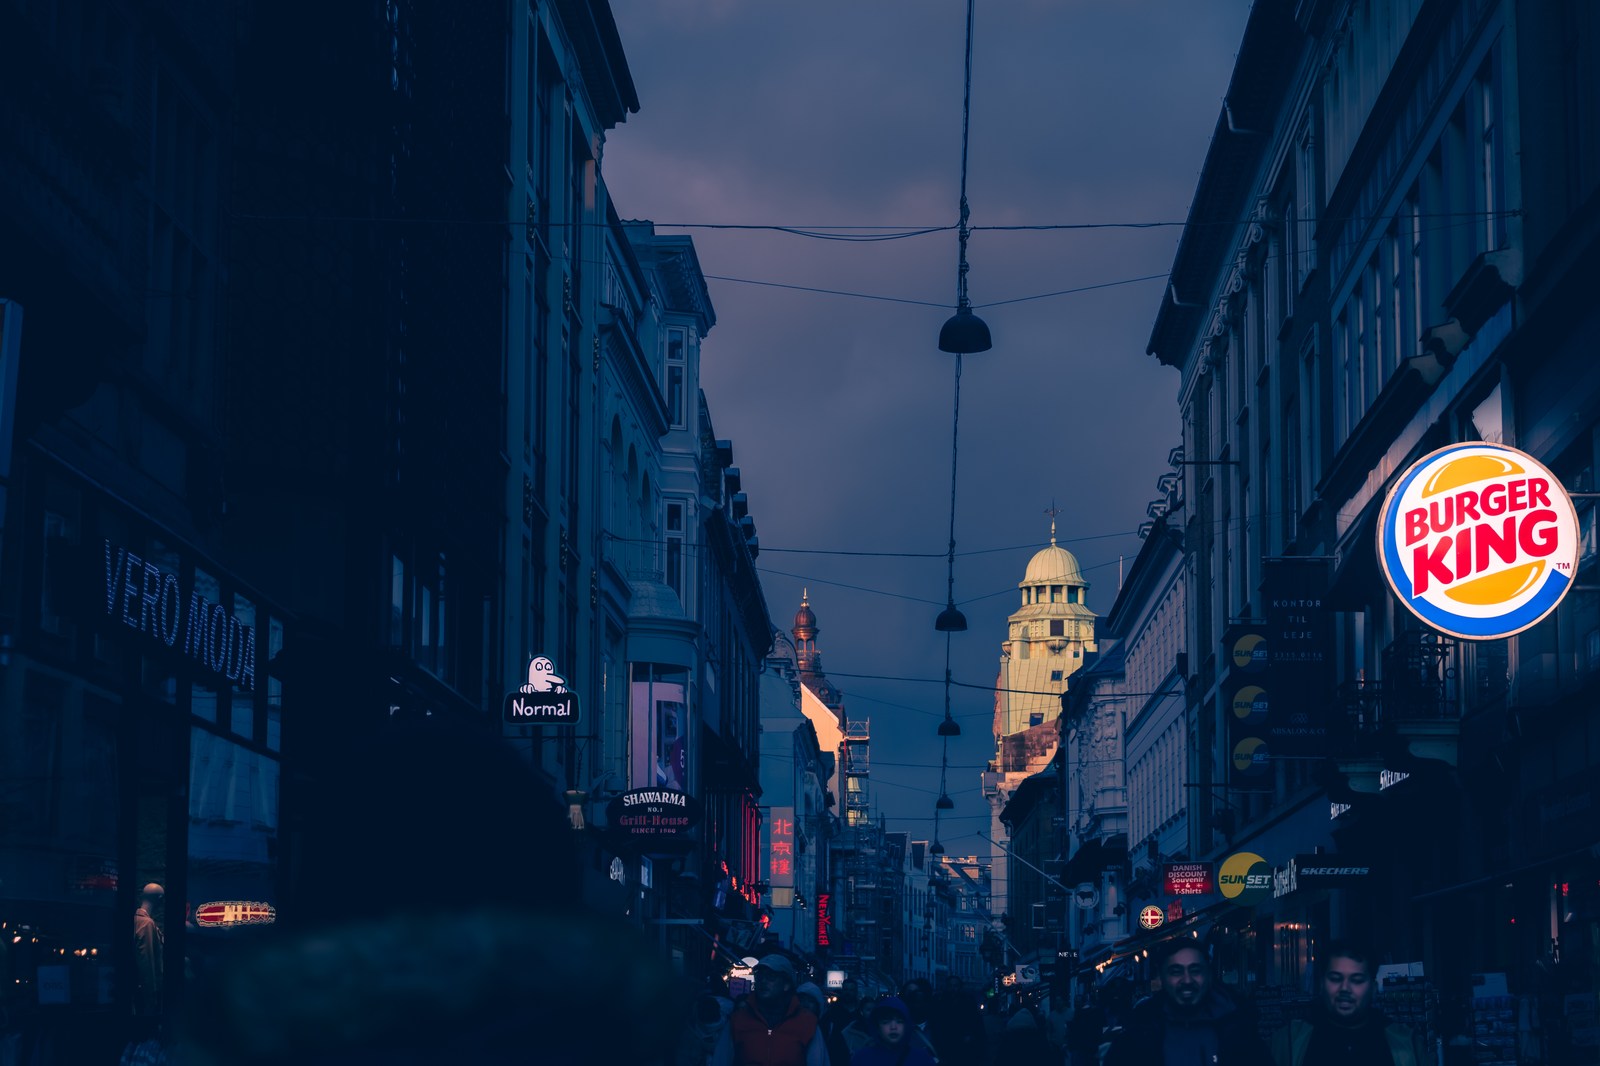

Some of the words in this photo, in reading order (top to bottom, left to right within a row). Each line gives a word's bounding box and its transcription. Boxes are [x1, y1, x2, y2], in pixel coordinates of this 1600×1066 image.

[1405, 477, 1551, 547] BURGER
[1413, 509, 1558, 597] KING
[1273, 599, 1321, 608] KONTOR
[104, 537, 181, 647] VERO
[184, 589, 256, 691] MODA
[1288, 615, 1308, 624] TIL
[1283, 631, 1313, 639] LEJE
[512, 697, 571, 717] Normal
[623, 792, 686, 807] SHAWARMA
[619, 815, 689, 826] Grill-House
[1168, 870, 1208, 878] DISCOUNT
[1300, 867, 1370, 875] SKECHERS
[1220, 875, 1271, 884] SUNSET
